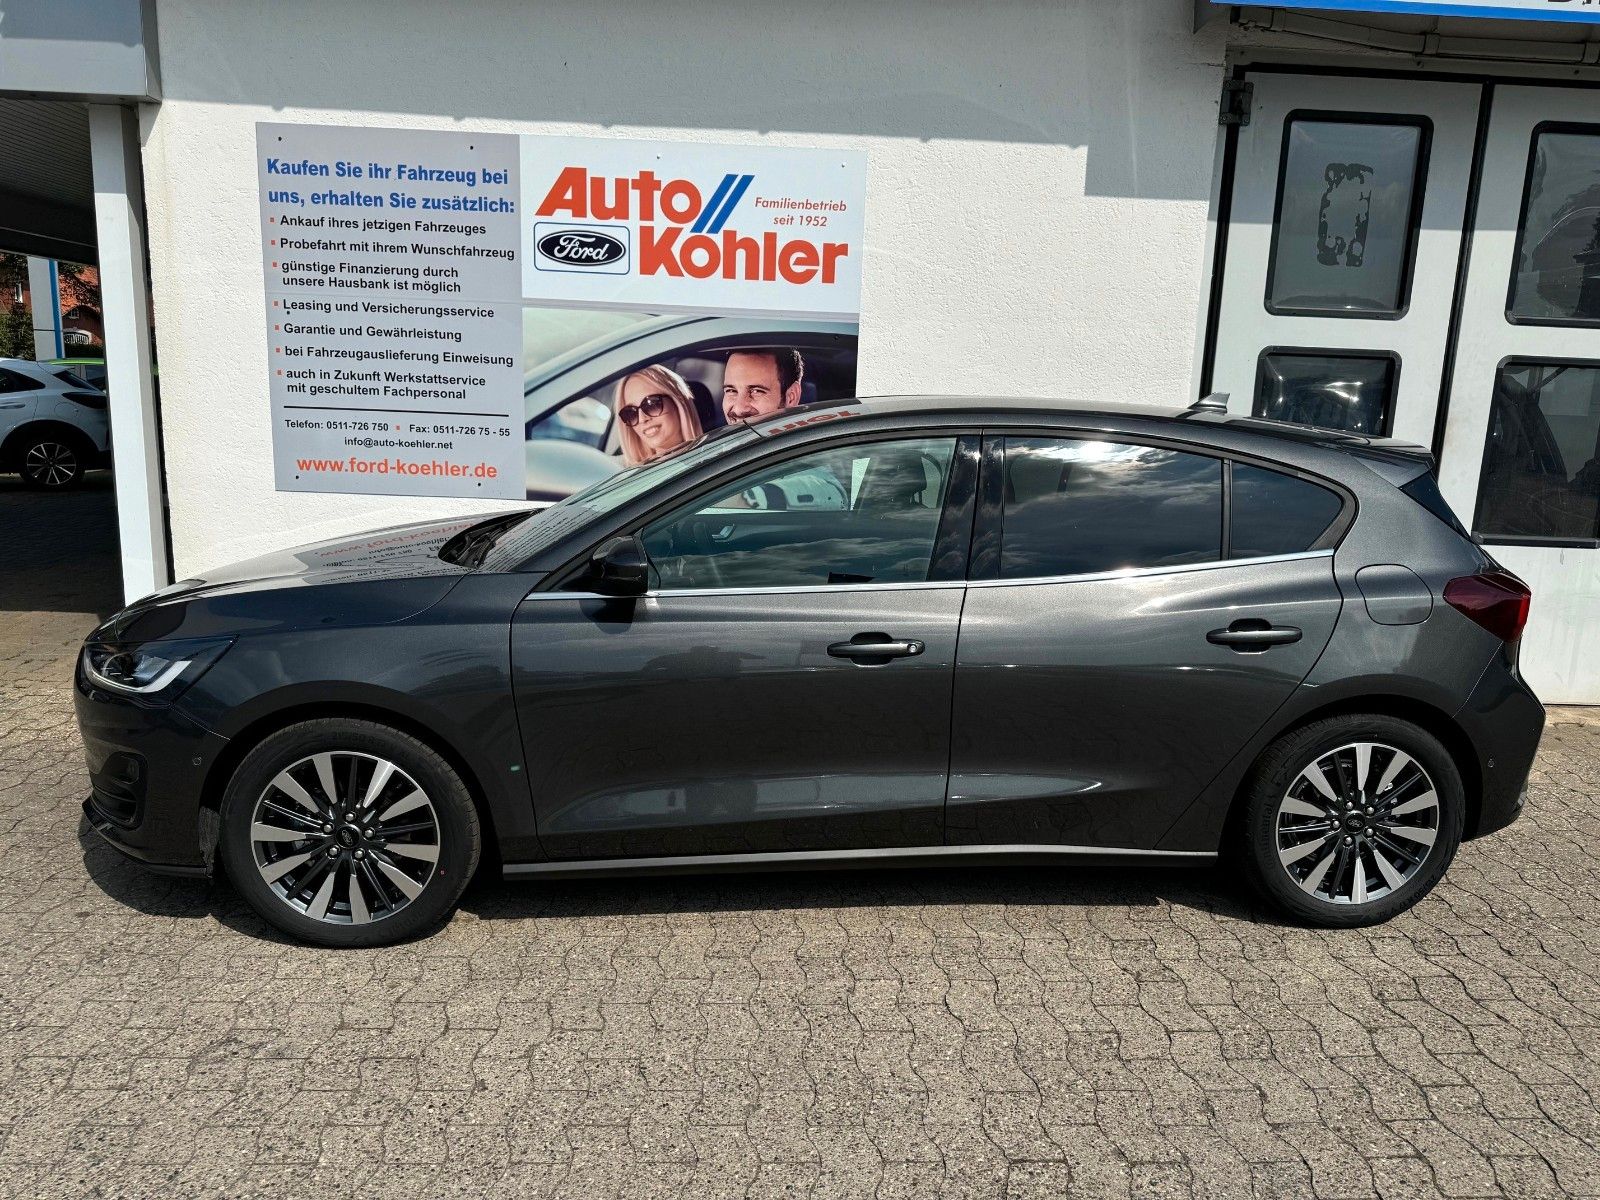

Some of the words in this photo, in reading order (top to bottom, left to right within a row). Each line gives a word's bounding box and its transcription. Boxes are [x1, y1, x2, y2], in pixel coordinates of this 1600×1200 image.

[267, 159, 330, 177] Kaufen
[335, 162, 363, 178] Sie
[369, 163, 391, 179] ihr
[397, 164, 476, 187] Fahrzeug
[482, 168, 508, 185] bei
[269, 190, 305, 207] uns,
[311, 190, 383, 208] erhalten
[390, 192, 417, 209] Sie
[422, 194, 514, 213] zusätzlich:
[535, 166, 702, 225] Auto
[755, 196, 847, 212] Familienbetrieb
[280, 215, 324, 228] Ankauf
[328, 217, 359, 229] ihres
[362, 219, 411, 232] jetzigen
[415, 221, 486, 235] Fahrzeuges
[773, 215, 795, 226] seit
[799, 215, 828, 227] 1952
[280, 238, 346, 252] Probefahrt
[350, 242, 369, 252] mit
[373, 242, 408, 254] ihrem
[411, 244, 515, 261] Wunschfahrzeug
[553, 235, 610, 262] Ford
[281, 261, 336, 274] günstige
[339, 263, 419, 278] Finanzierung
[423, 266, 459, 278] durch
[282, 276, 325, 287] unsere
[328, 277, 390, 290] Hausbank
[393, 280, 409, 290] ist
[412, 281, 461, 294] möglich
[283, 299, 331, 313] Leasing
[335, 301, 358, 312] und
[362, 302, 495, 318] Versicherungsservice
[284, 323, 336, 335] Garantie
[340, 325, 363, 336] und
[366, 326, 462, 343] Gewährleistung
[285, 346, 303, 357] bei
[307, 347, 439, 364] Fahrzeugauslieferung
[443, 352, 514, 367] Einweisung
[286, 368, 316, 380] auch
[320, 370, 330, 380] in
[334, 370, 381, 382] Zukunft
[384, 372, 486, 386] Werkstattservice
[287, 383, 306, 394] mit
[310, 384, 380, 398] geschultem
[383, 386, 466, 399] Fachpersonal
[285, 419, 324, 429] Telefon:
[326, 421, 369, 431] 0511-726
[372, 422, 389, 431] 750
[409, 424, 430, 434] Fax:
[433, 426, 476, 435] 0511-726
[479, 427, 490, 436] 75
[499, 428, 510, 437] 55
[344, 438, 453, 450] info@auto-koehler.net
[297, 457, 498, 478] www.ford-koehler.de
